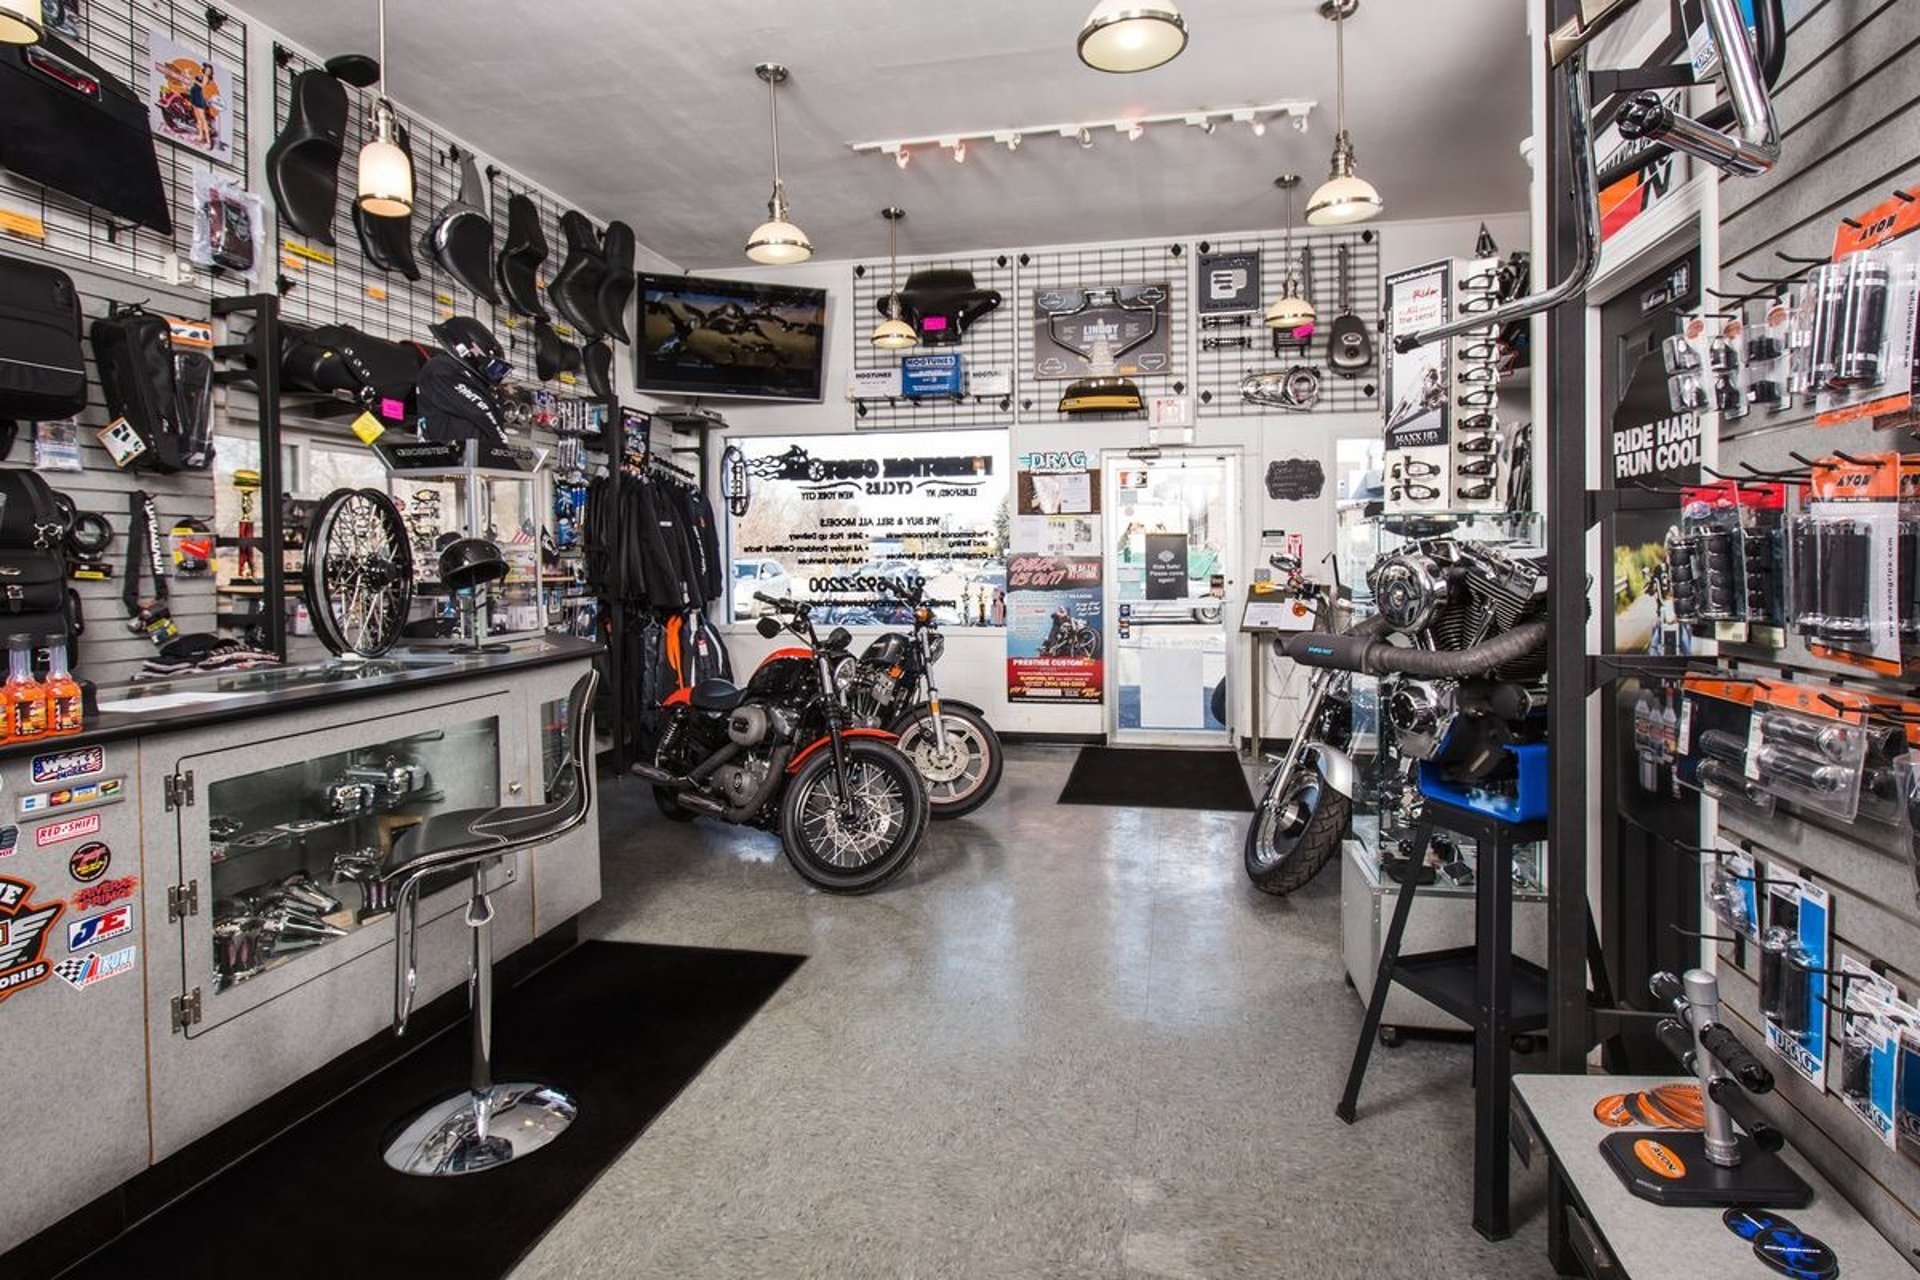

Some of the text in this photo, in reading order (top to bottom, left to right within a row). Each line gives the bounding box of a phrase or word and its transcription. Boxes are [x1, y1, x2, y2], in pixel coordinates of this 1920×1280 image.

[1858, 214, 1898, 242] AVON
[1613, 423, 1654, 455] RIDE
[1029, 451, 1088, 471] DRAG
[1615, 438, 1700, 479] RUN COOL
[1836, 474, 1872, 487] AVON
[39, 816, 98, 841] RED SHIFT
[71, 908, 128, 949] JE
